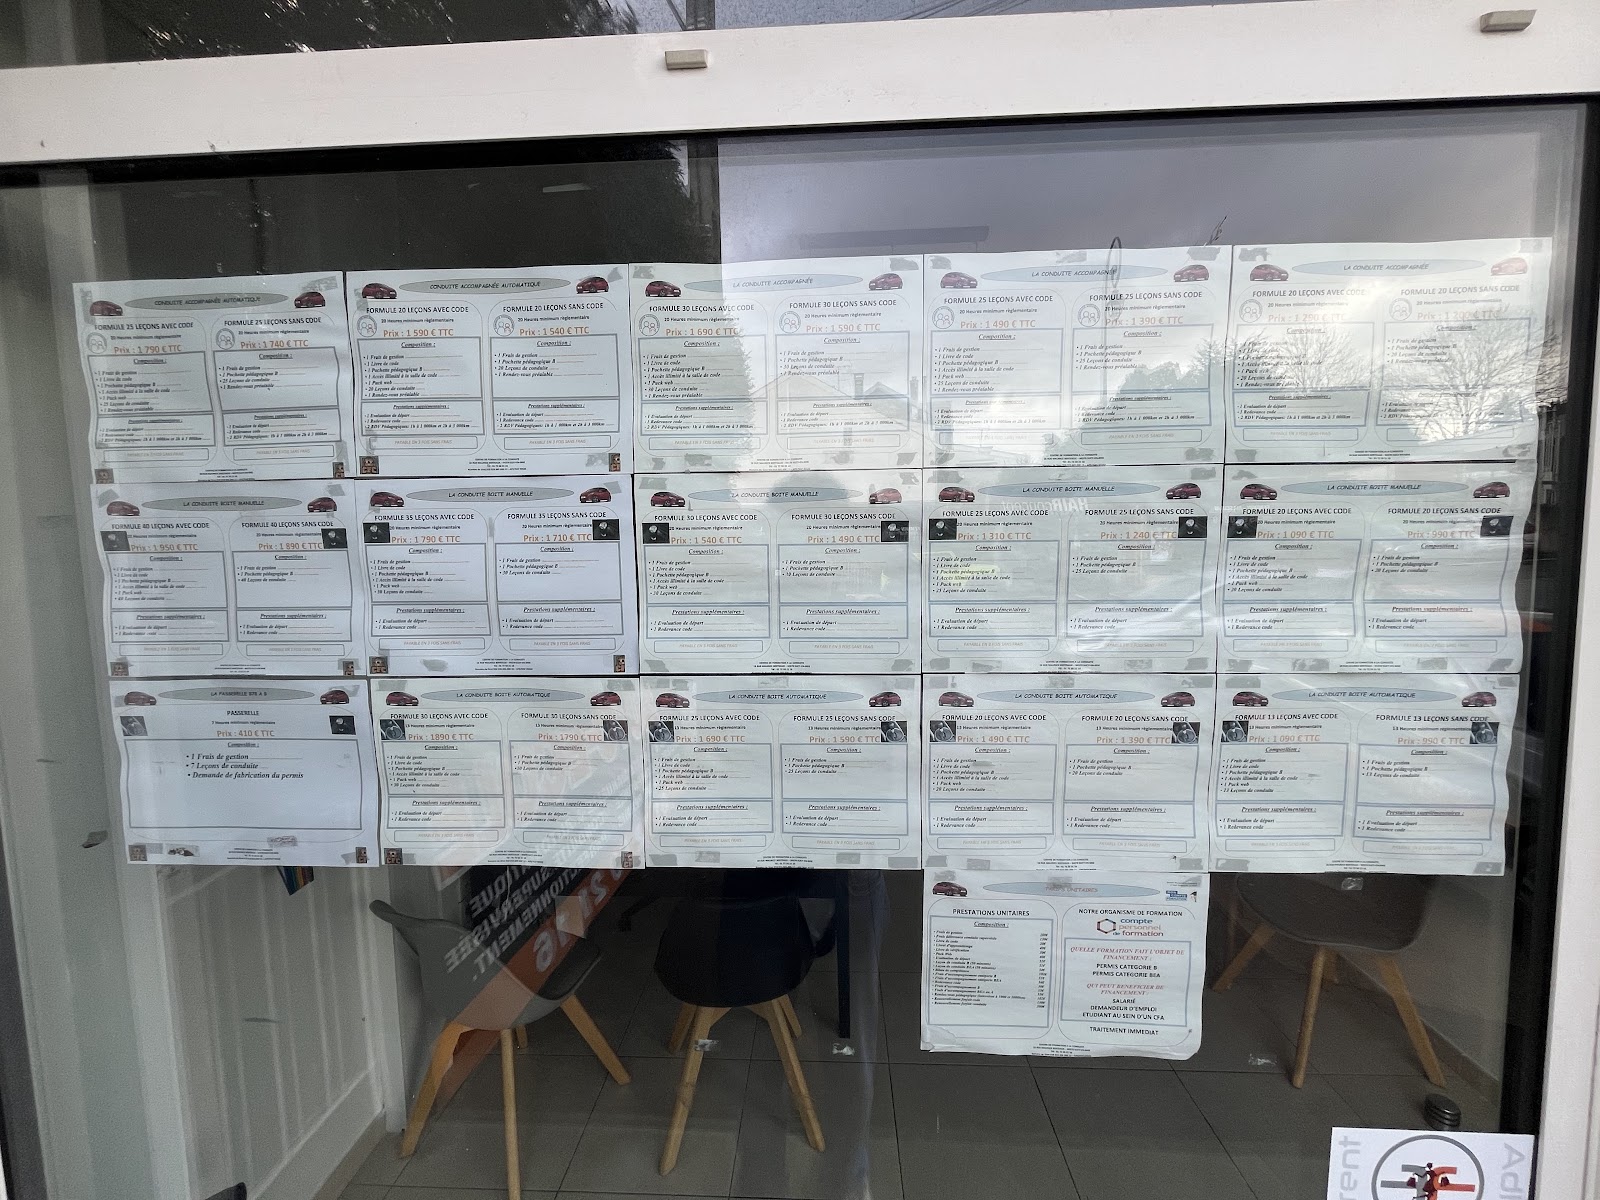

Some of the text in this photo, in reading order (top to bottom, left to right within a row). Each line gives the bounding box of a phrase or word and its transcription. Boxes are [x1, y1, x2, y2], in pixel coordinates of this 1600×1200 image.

[943, 296, 976, 304] FORMULE
[391, 535, 407, 543] Prix
[420, 535, 436, 543] 790
[1089, 1026, 1126, 1034] TRAITEMENT
